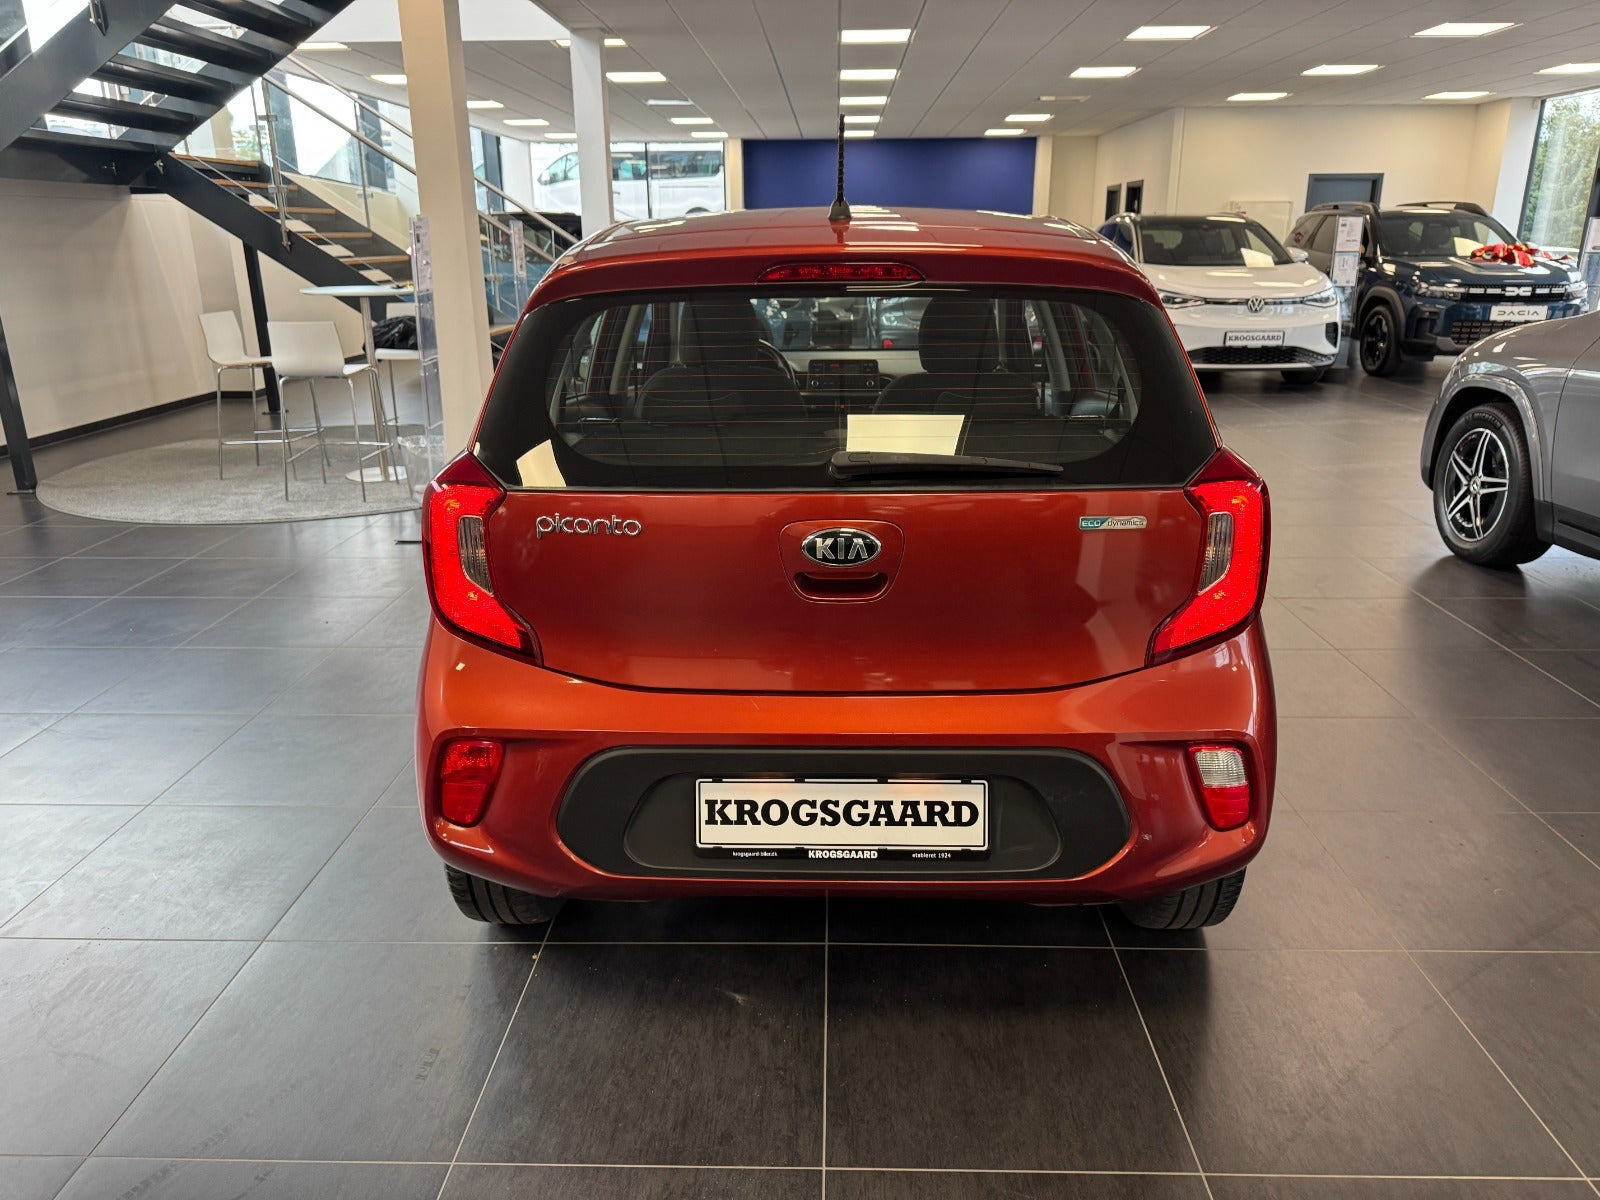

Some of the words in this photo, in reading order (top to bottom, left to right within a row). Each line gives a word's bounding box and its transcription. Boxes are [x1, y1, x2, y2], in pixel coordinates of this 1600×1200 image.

[536, 513, 641, 539] picanto
[1107, 519, 1144, 527] dynamics
[815, 538, 869, 560] KIA
[704, 799, 980, 827] KROGSGAARD
[808, 850, 878, 859] KROGSGAARD
